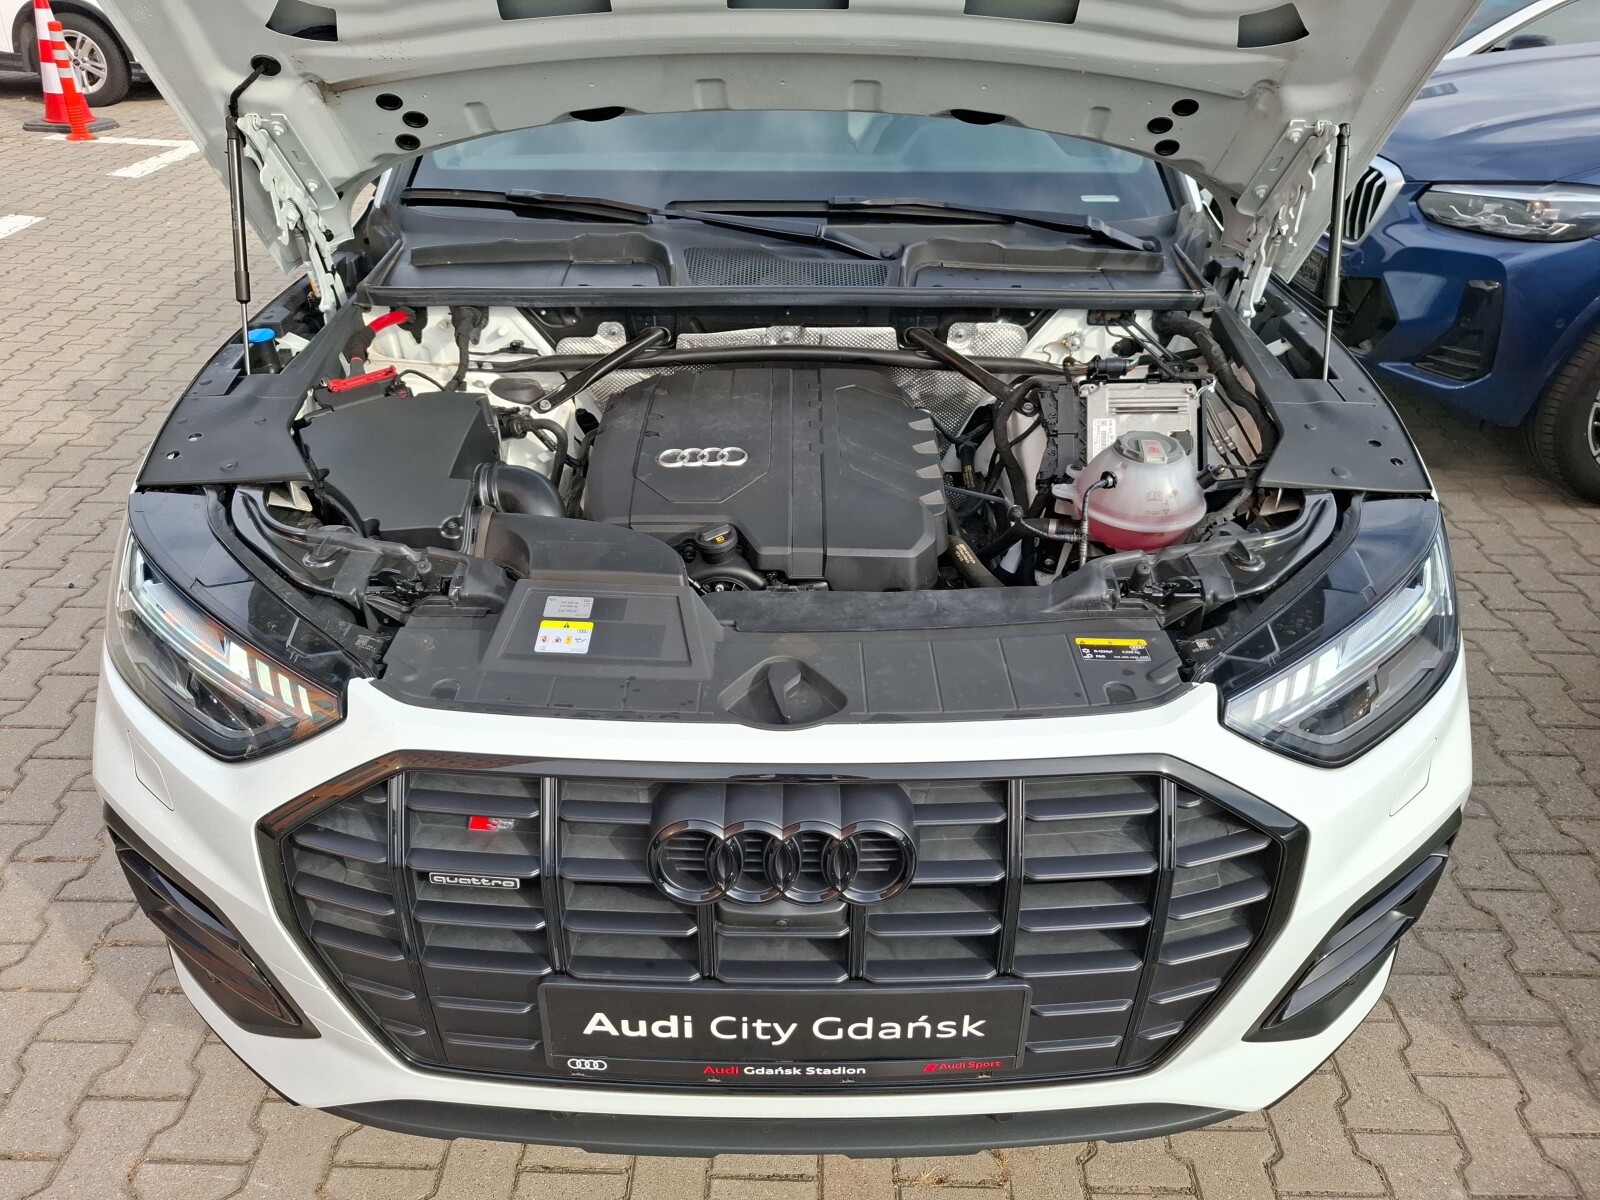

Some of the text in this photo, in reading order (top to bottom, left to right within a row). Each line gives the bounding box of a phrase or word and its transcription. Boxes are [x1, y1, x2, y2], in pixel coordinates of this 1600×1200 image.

[433, 876, 515, 887] quattro
[583, 1012, 986, 1046] Audi City Gdańsk
[703, 1065, 866, 1076] Audi Gdańsk Stadion
[938, 1060, 1002, 1070] Audi Sport
